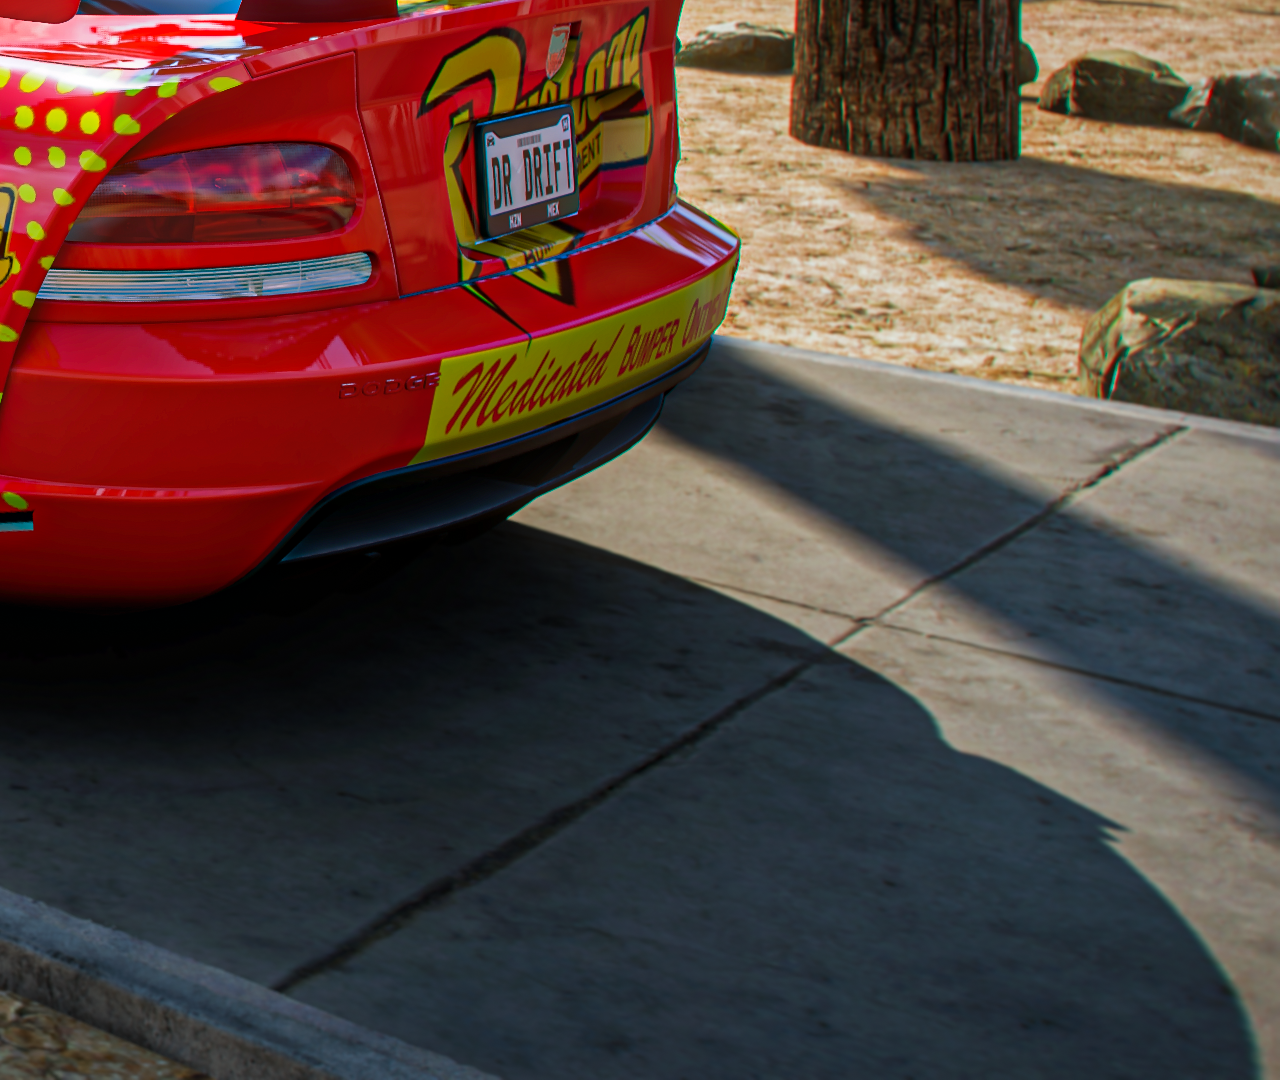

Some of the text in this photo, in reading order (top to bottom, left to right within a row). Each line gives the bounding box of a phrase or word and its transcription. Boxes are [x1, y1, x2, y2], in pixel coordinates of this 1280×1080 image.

[491, 138, 571, 210] DR DRIFT
[509, 201, 560, 229] HZN MEX
[339, 371, 441, 400] DODGE
[444, 323, 625, 434] Medicated
[617, 318, 680, 377] BUMPER
